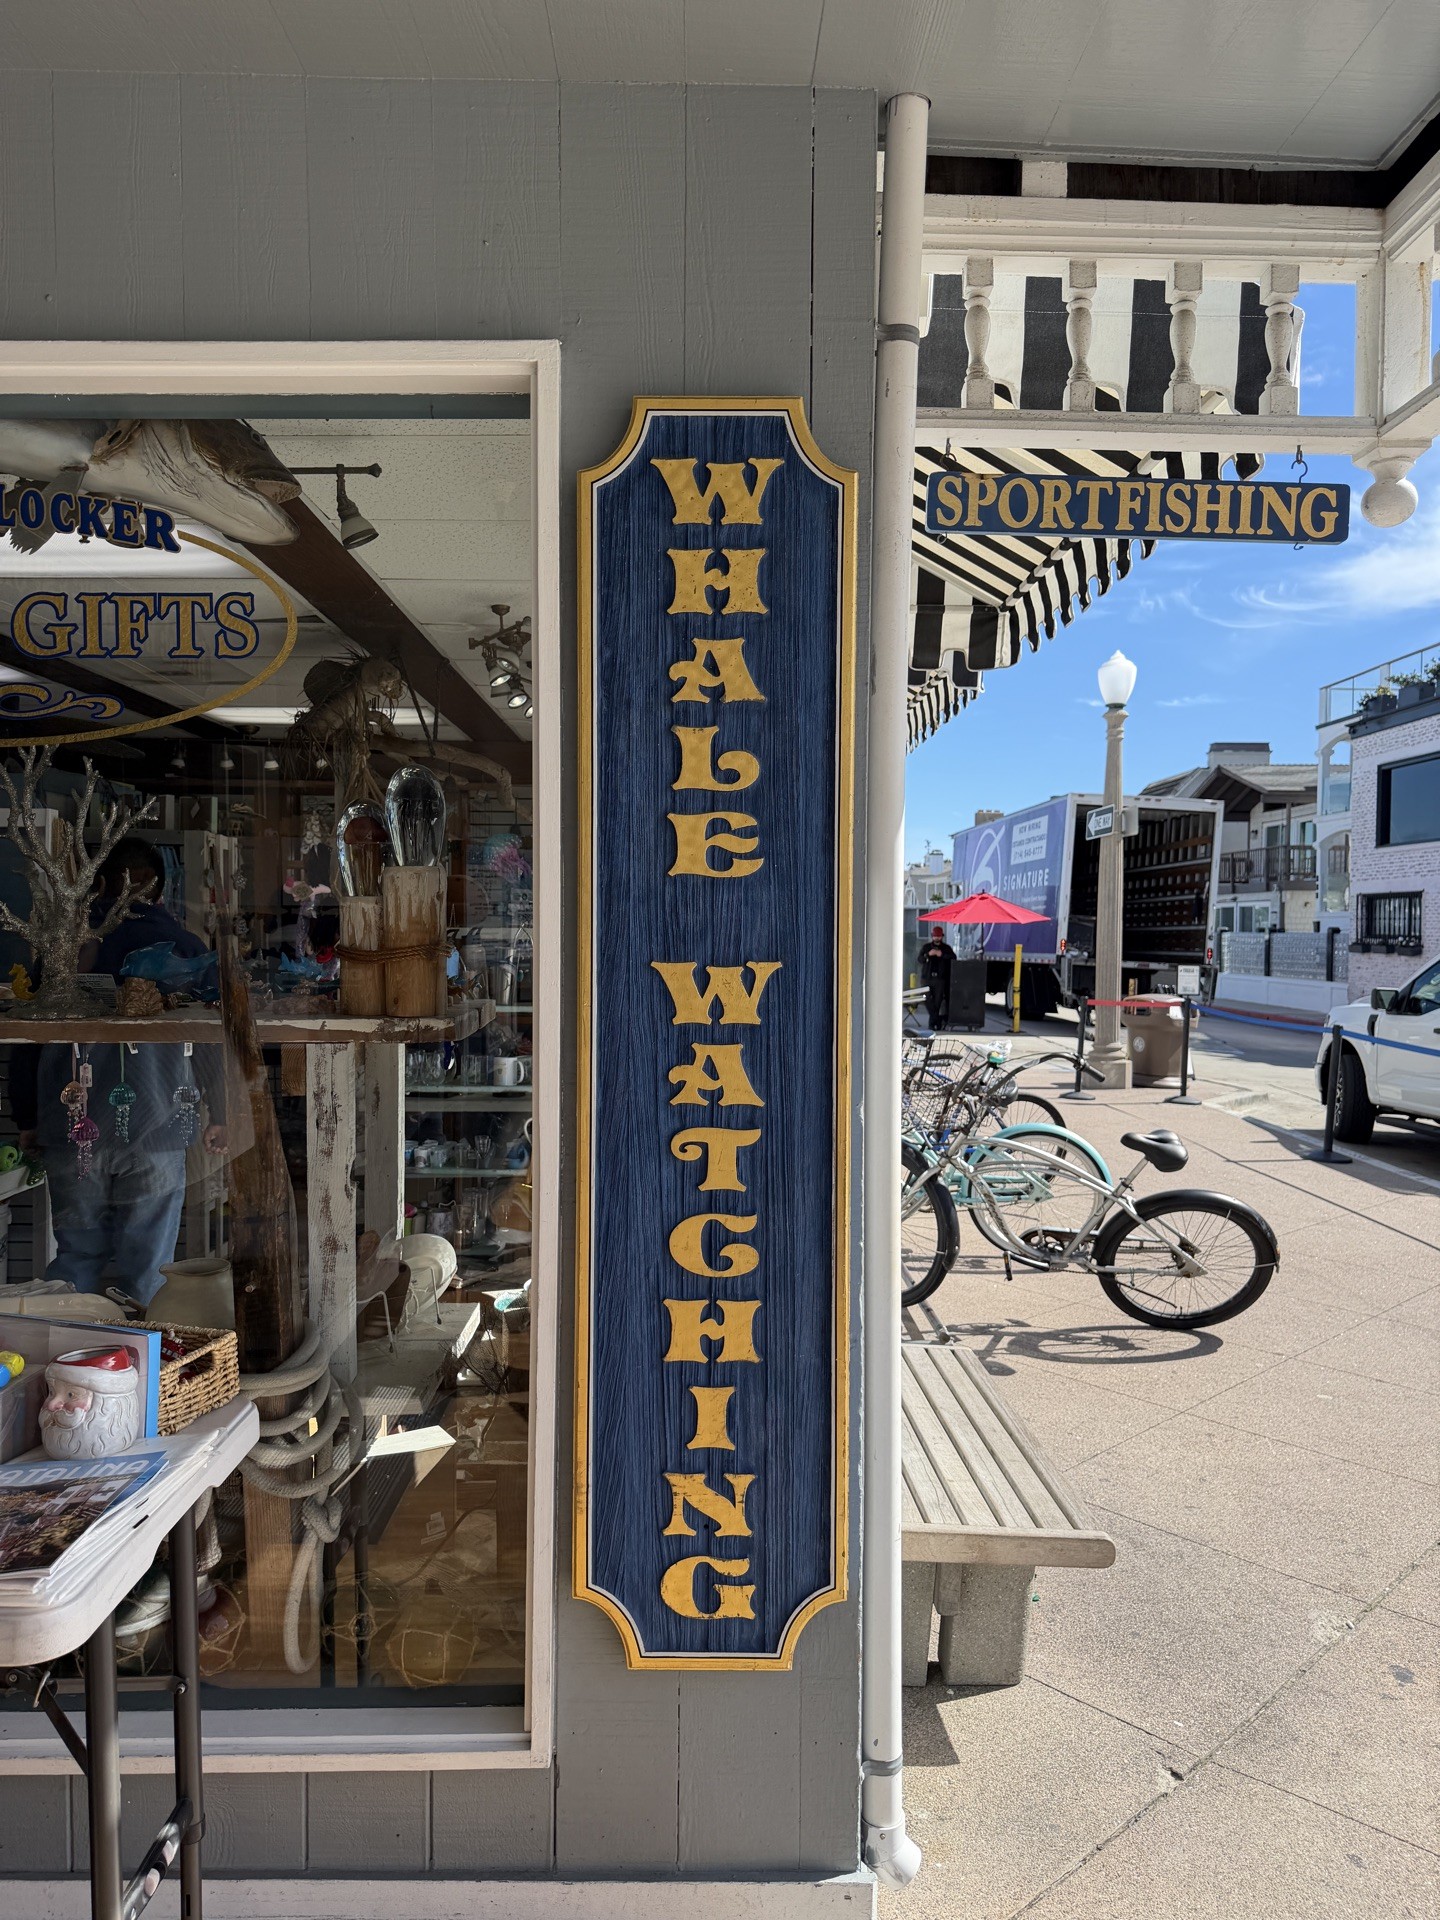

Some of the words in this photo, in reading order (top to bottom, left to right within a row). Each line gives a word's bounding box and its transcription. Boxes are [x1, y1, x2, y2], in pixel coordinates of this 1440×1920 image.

[935, 475, 1340, 539] SPORTFISHING
[10, 592, 260, 659] GIFTS
[650, 457, 786, 878] WHALE
[1003, 868, 1049, 891] SIGNATURE
[650, 960, 783, 1621] WATCHING
